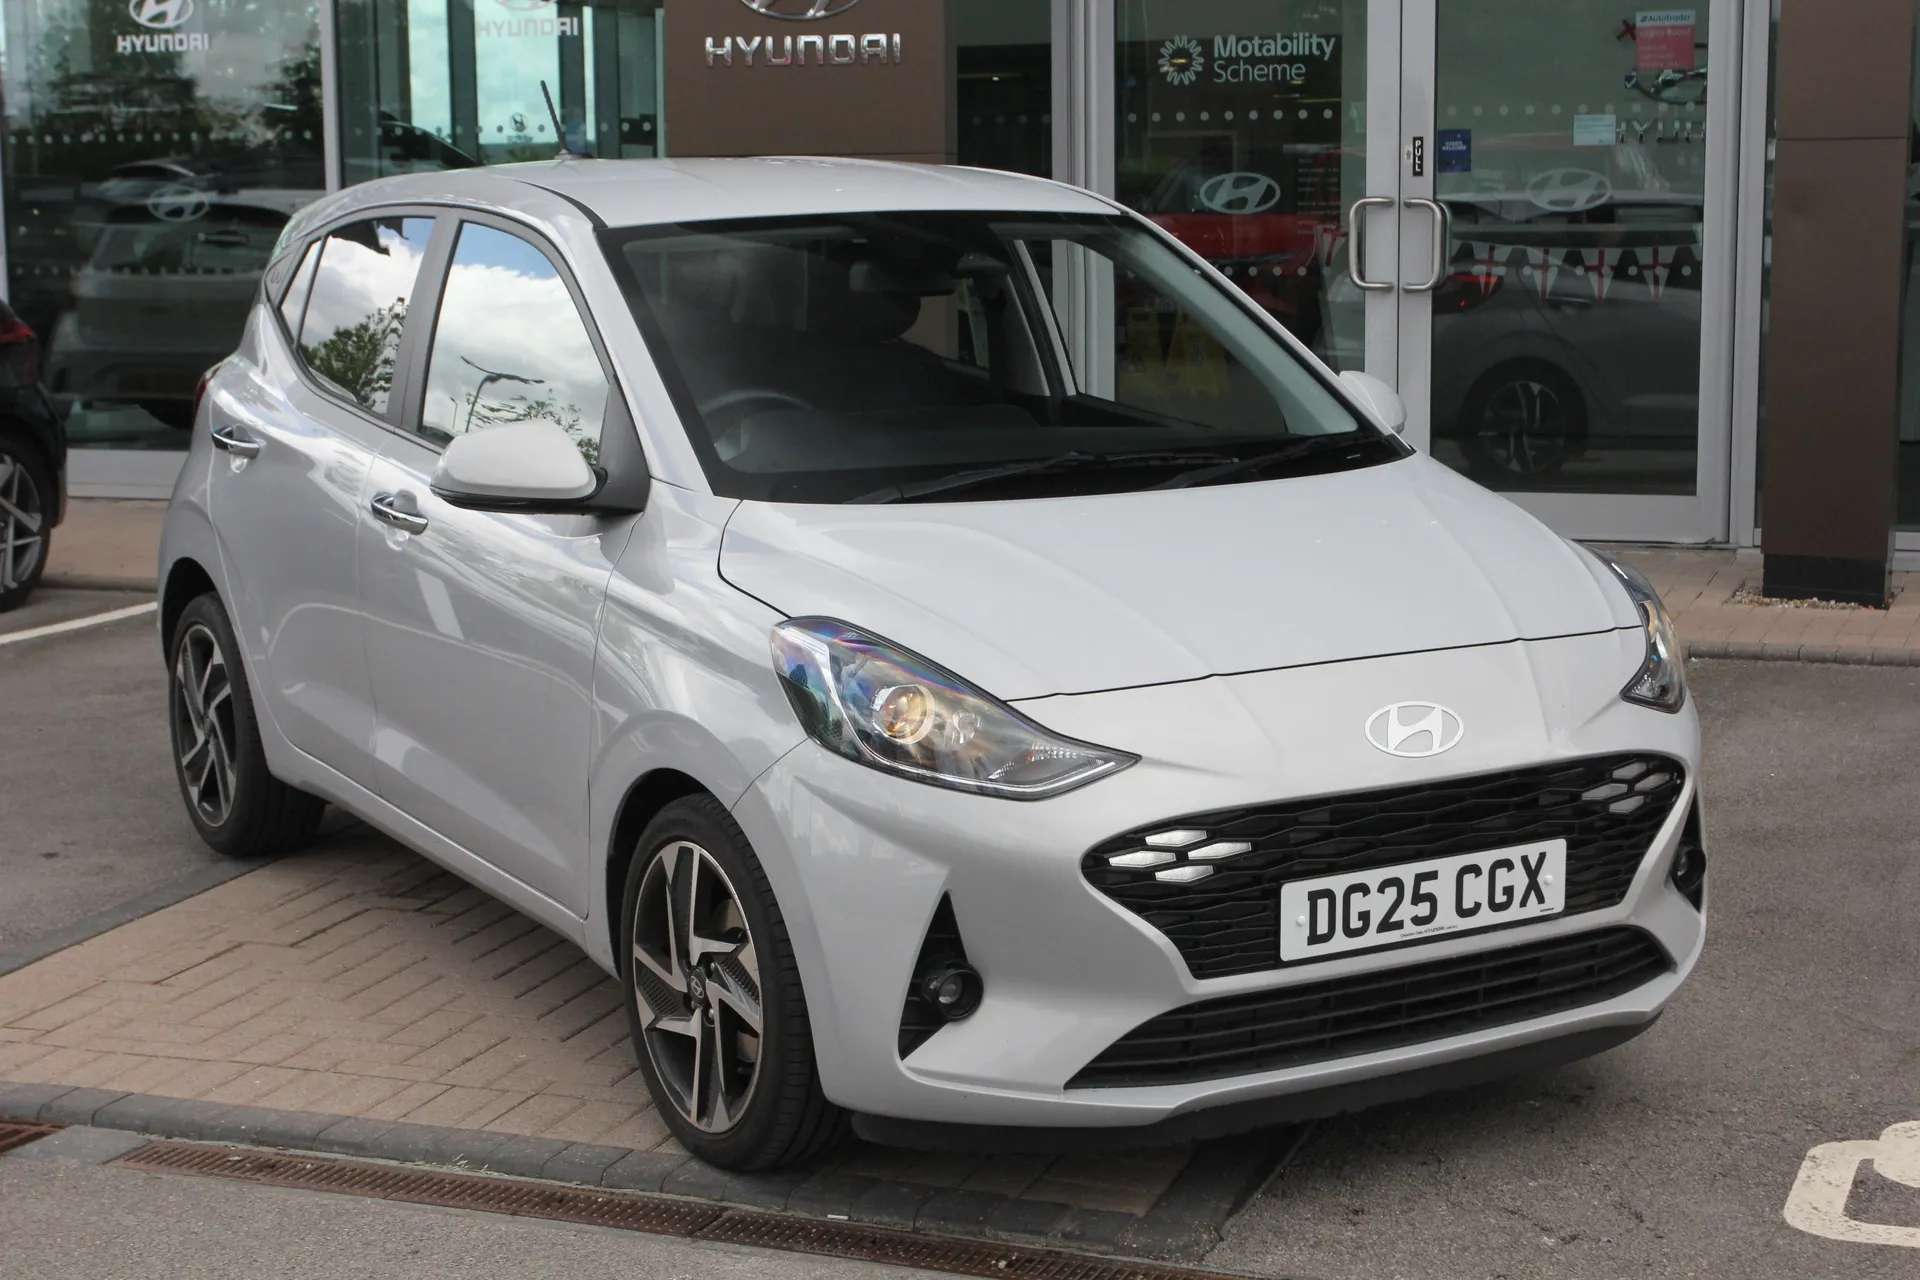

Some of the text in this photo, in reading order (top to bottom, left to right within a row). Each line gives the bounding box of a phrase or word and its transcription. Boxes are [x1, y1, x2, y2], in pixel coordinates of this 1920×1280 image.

[475, 17, 579, 37] HYUNDAI
[116, 33, 209, 54] HYUNDAI
[705, 33, 900, 66] HYUNDAI
[1213, 32, 1336, 61] Motability
[1213, 59, 1306, 83] Scheme
[1307, 852, 1547, 946] DG25 CGX
